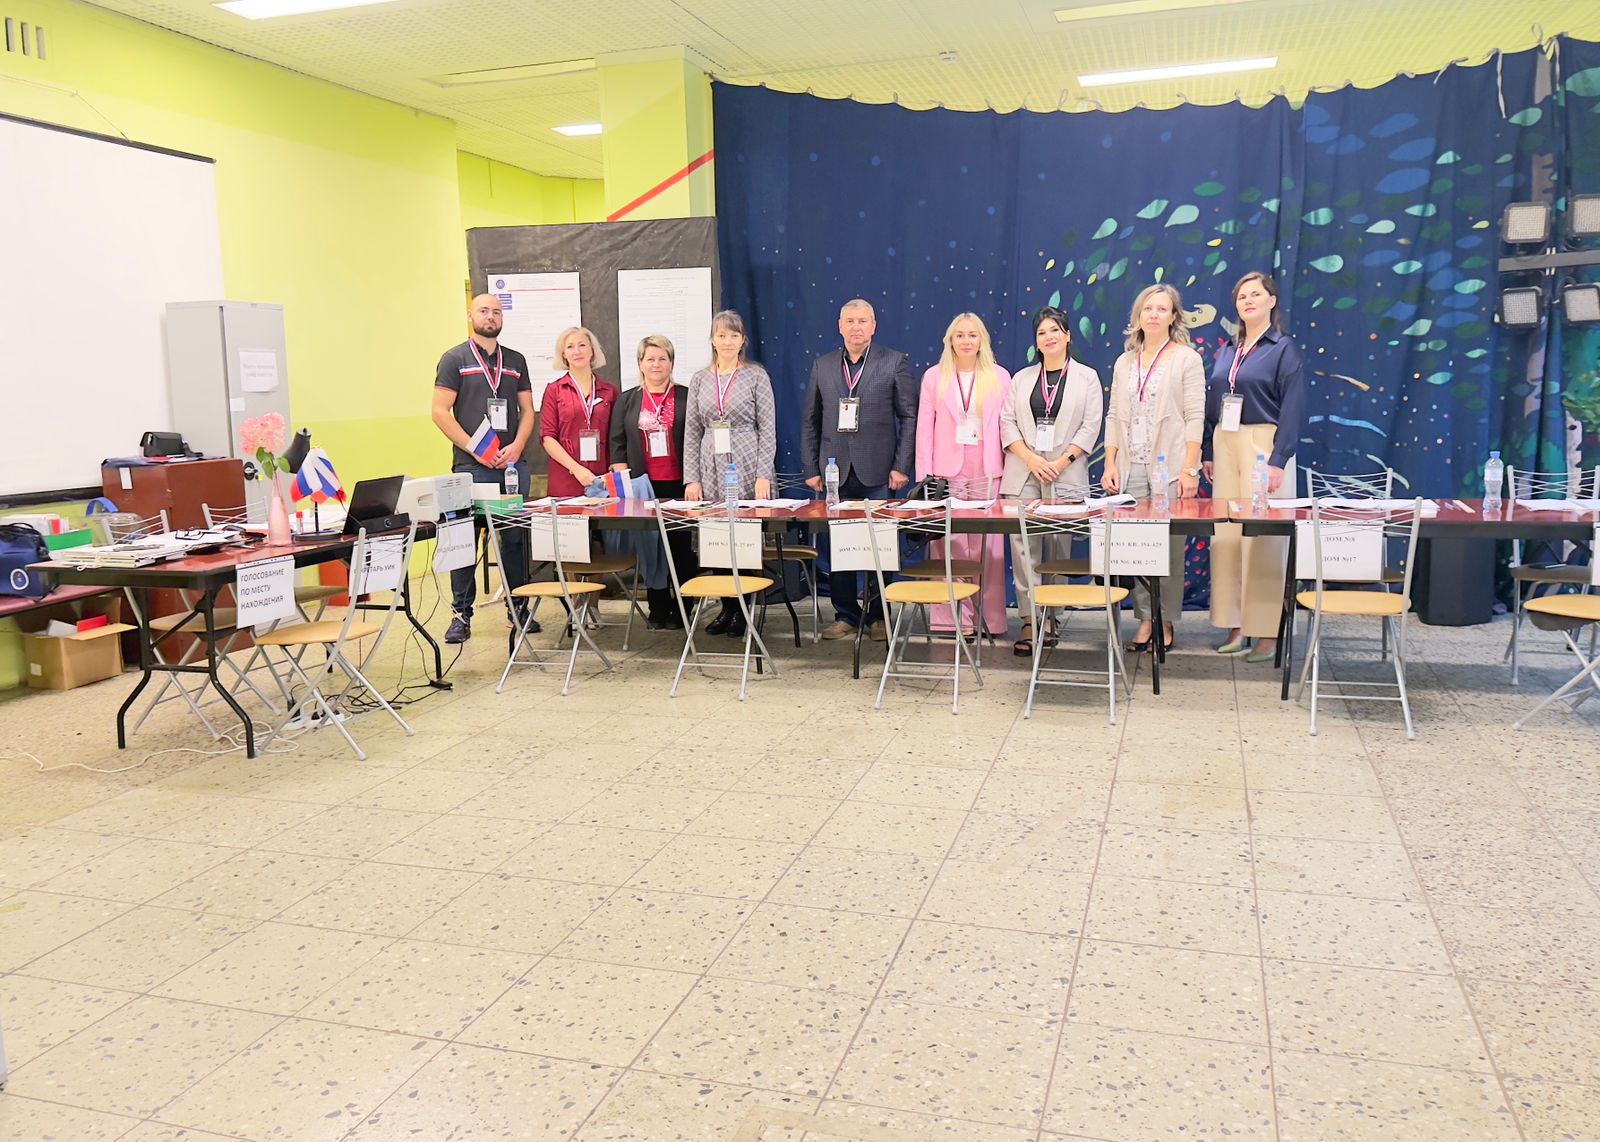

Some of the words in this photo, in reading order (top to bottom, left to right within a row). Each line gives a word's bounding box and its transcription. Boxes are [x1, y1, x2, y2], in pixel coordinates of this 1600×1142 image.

[240, 568, 284, 582] ГОЛОСОВАНИЕ
[240, 588, 250, 596] ПО
[251, 584, 271, 594] МЕСТУ
[240, 595, 284, 610] НАХОЖДЕНИЯ
